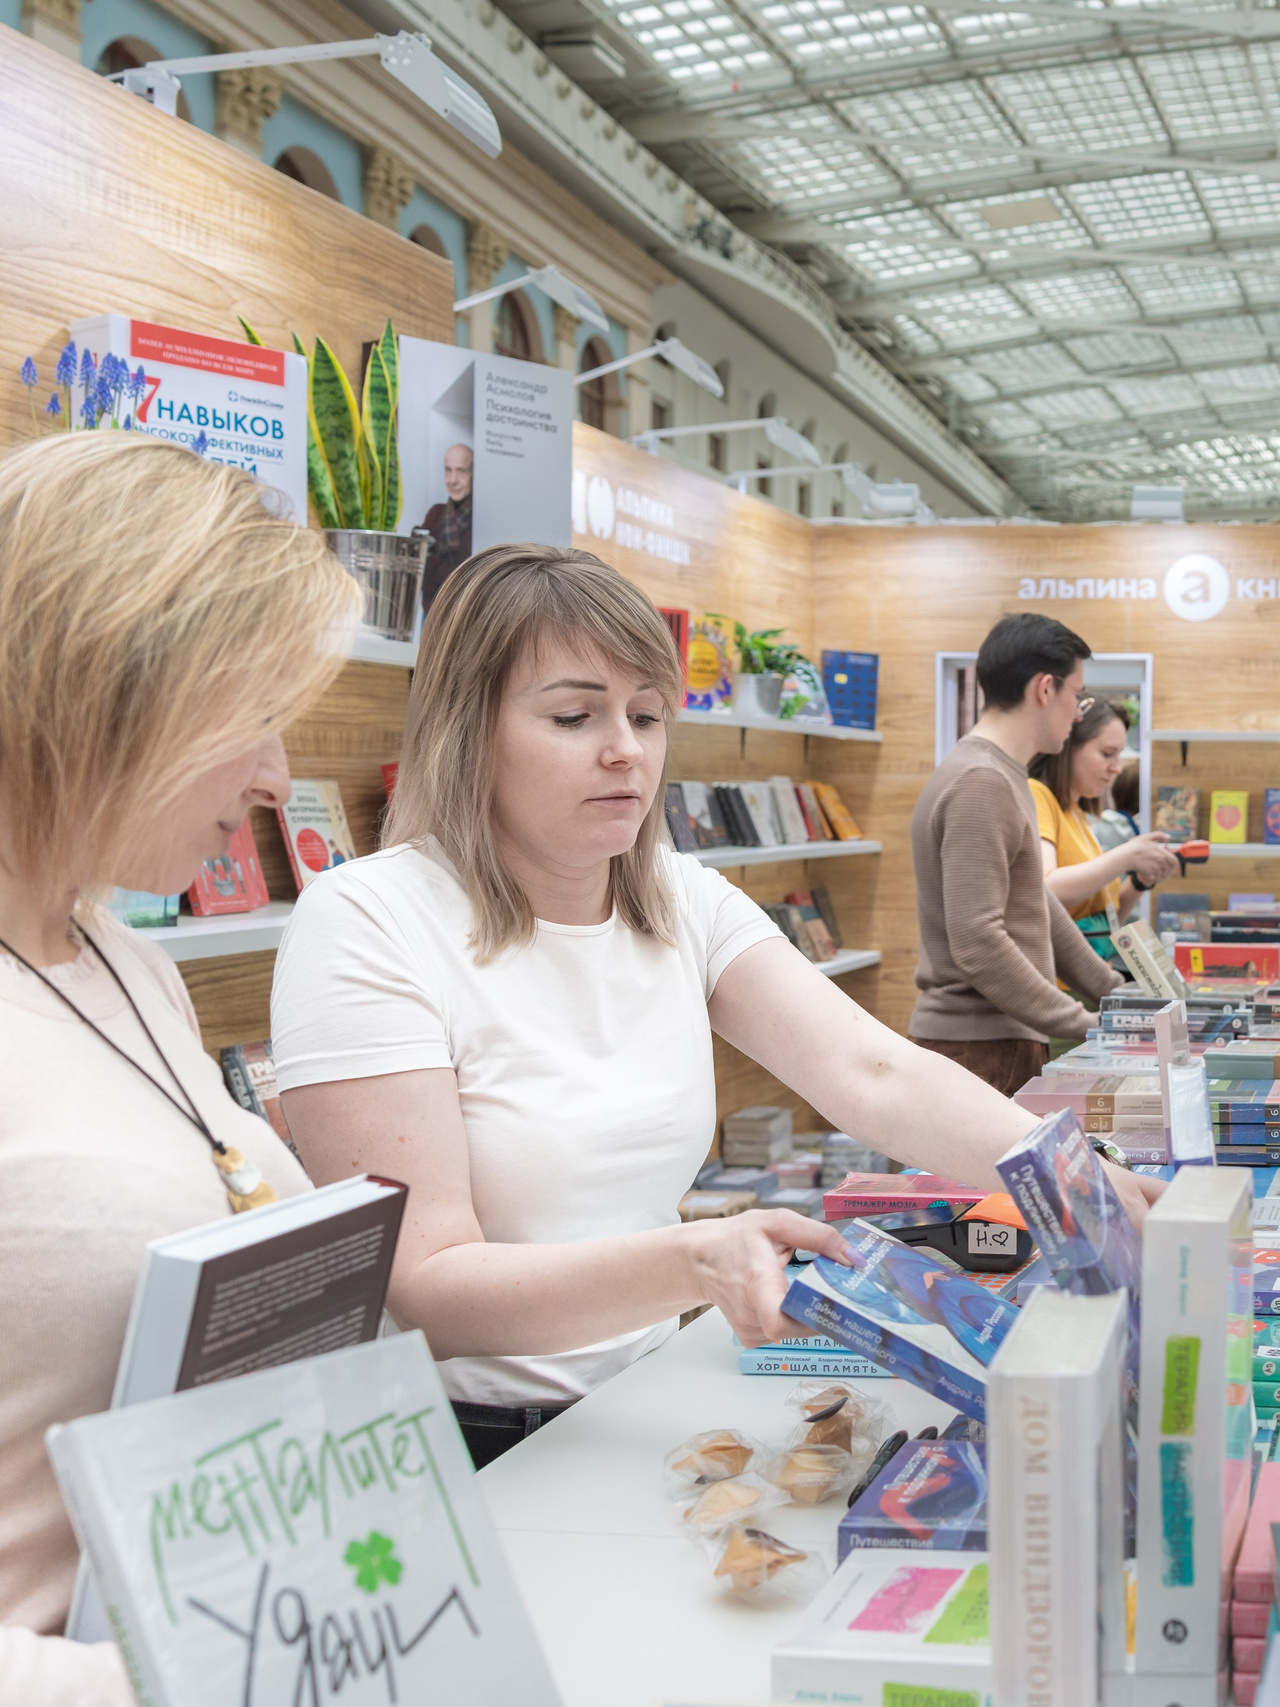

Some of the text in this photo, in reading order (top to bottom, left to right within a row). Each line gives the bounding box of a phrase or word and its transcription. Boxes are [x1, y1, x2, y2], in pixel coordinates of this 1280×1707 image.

[486, 371, 549, 396] Александр
[486, 384, 536, 403] Асмолов
[130, 372, 285, 440] 7 НАВЫКОВ
[486, 398, 553, 421] Психология
[485, 413, 558, 434] достоинства
[135, 423, 285, 460] ЫСОКОЭФЕКТИВНЫХ
[1018, 576, 1158, 600] альпина
[1096, 1097, 1105, 1108] 6
[843, 1200, 918, 1209] ТРЕНАЖЕР МОЗГА
[1020, 1163, 1067, 1244] Путешествие
[810, 1295, 842, 1322] Тайны
[803, 1306, 897, 1365] бессознательного
[814, 1338, 843, 1347] ПАМ
[842, 1316, 884, 1344] нашего
[823, 1364, 878, 1374] ПАМЯТЬ
[937, 1375, 974, 1402] Андрей
[1173, 1344, 1191, 1431] ТЕРАПИЯ
[1018, 1395, 1050, 1474] ДОМ
[849, 1532, 934, 1550] Путешествие
